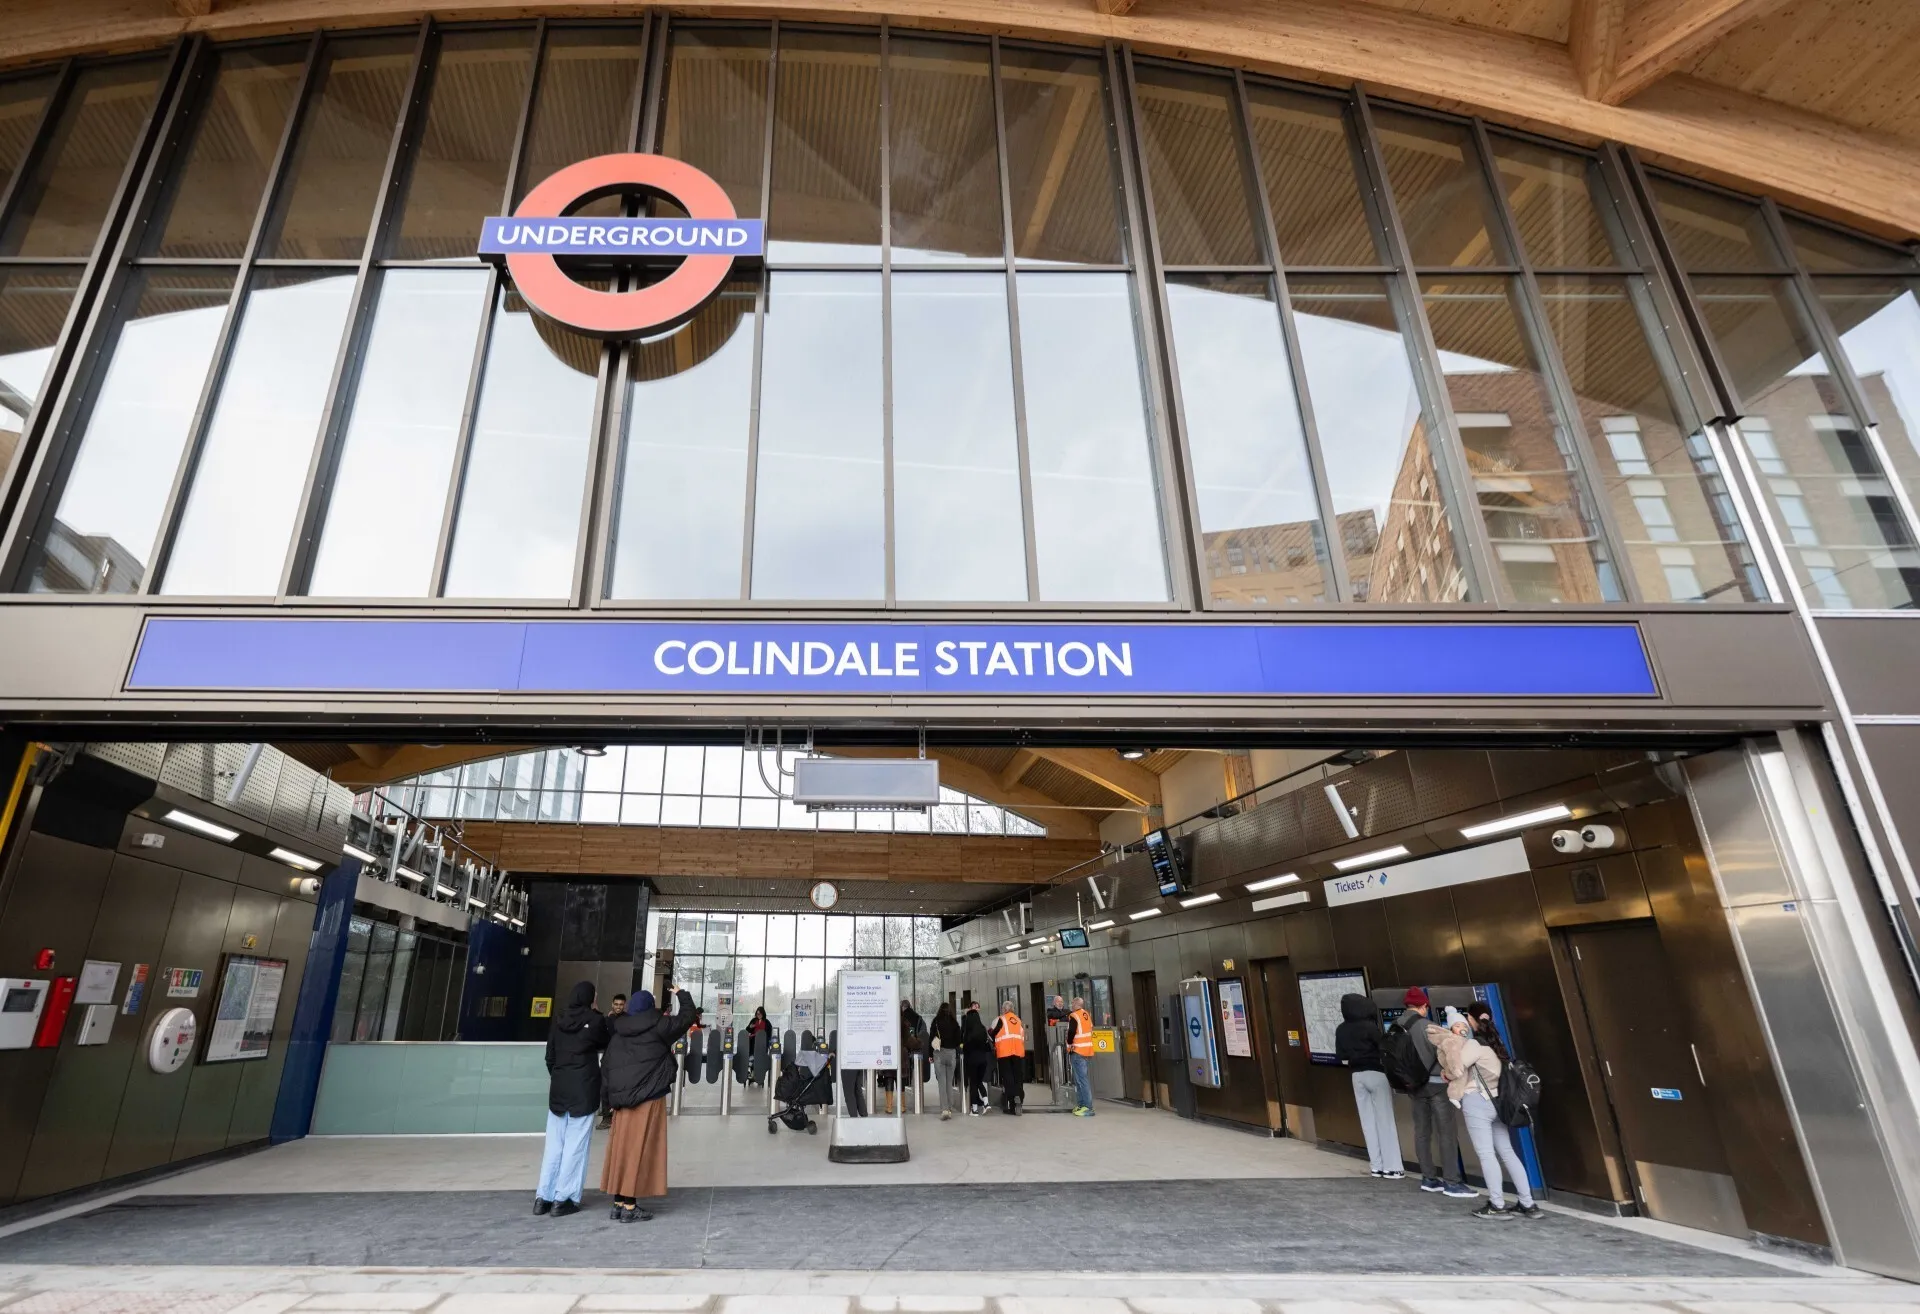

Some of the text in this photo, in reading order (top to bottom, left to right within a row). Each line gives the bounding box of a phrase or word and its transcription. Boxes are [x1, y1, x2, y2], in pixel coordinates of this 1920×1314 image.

[497, 225, 748, 247] UNDERGROUND
[654, 640, 1133, 677] COLINDALE STATION
[1335, 880, 1364, 893] Tickets
